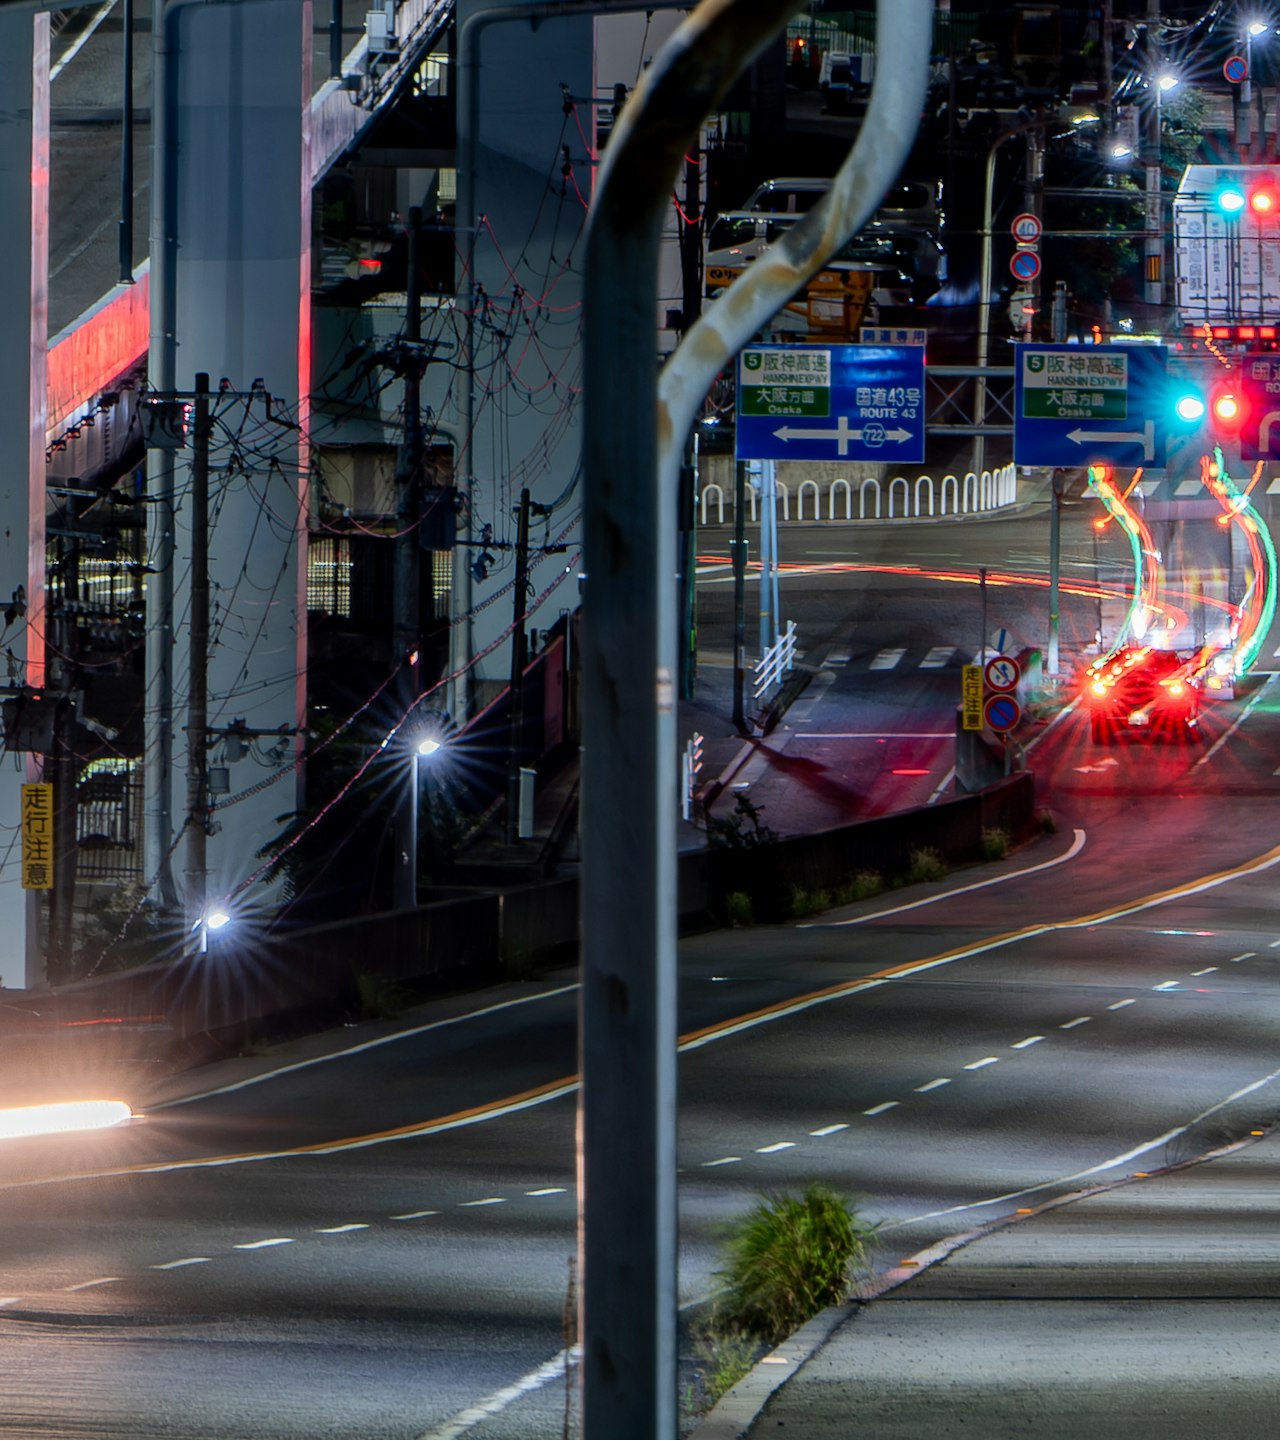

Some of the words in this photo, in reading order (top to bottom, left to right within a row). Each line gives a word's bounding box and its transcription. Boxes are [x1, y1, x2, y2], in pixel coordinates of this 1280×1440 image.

[1018, 222, 1036, 236] 40
[748, 354, 758, 368] 5
[763, 353, 828, 373] 阪神高速
[1031, 358, 1041, 369] 5
[1047, 355, 1125, 375] 阪神高速
[762, 373, 798, 384] HANSHIN
[1047, 376, 1089, 386] HANSHIN
[1090, 377, 1125, 387] EXPWY
[756, 387, 815, 404] 大阪方面
[856, 387, 922, 408] 国道43号
[1046, 390, 1105, 407] 大阪方面
[767, 405, 803, 415] Osaka
[859, 407, 898, 419] ROUTE
[901, 408, 917, 419] 43
[1058, 407, 1092, 418] Osaka
[864, 429, 884, 443] 722
[25, 786, 49, 886] 走行注意
